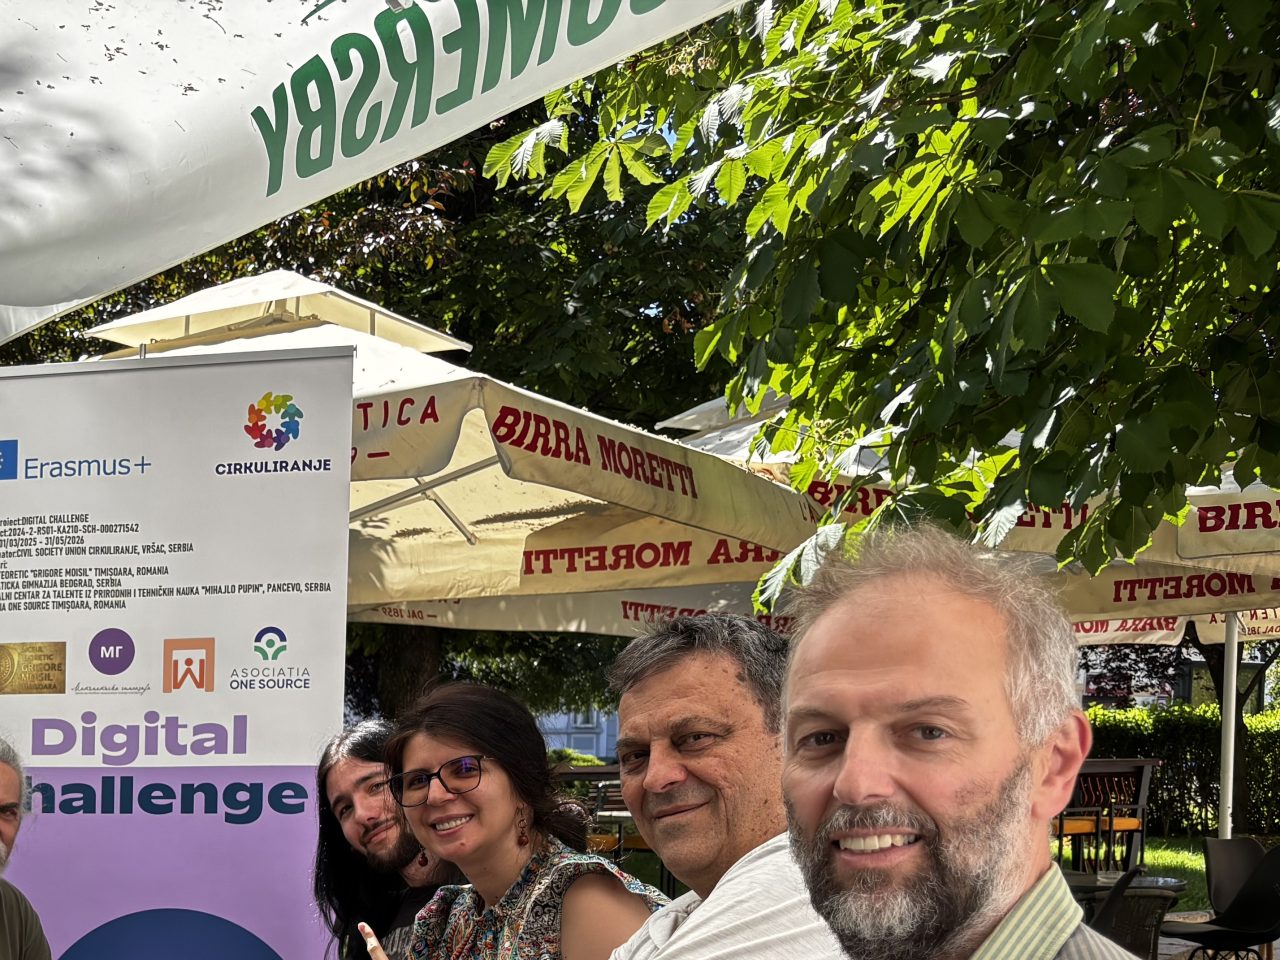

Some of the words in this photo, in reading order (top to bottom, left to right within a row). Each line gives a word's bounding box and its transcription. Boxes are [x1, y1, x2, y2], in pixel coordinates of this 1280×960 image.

[356, 395, 439, 431] TICA
[492, 405, 591, 466] BIRRA
[596, 434, 699, 499] MORETTI
[24, 455, 151, 480] Erasmus+
[215, 459, 331, 475] CIRKULIRANJE
[49, 514, 89, 524] CHALLENGE
[1197, 500, 1280, 533] BIR
[44, 536, 84, 546] 31/05/2026
[35, 547, 63, 557] SOCIETY
[65, 546, 86, 555] UNION
[88, 545, 140, 556] CIRKULIRANJE,
[168, 543, 194, 553] SERBIA
[30, 568, 63, 578] "GRIGORE
[65, 568, 92, 577] MOISIL"
[136, 566, 168, 576] ROMANIA
[14, 591, 40, 600] CENTAR
[42, 590, 51, 599] ZA
[52, 589, 83, 599] TALENTE
[85, 589, 91, 598] IZ
[93, 588, 131, 598] PRIRODNIH
[176, 587, 199, 596] NAUKA
[201, 584, 236, 595] "MIHAJLO
[305, 582, 332, 592] SERBIA
[22, 579, 58, 590] GIMNAZIJA
[59, 579, 94, 589] BEOGRAD,
[96, 578, 122, 588] SERBIA
[8, 602, 22, 611] ONE
[24, 600, 50, 610] SOURCE
[94, 599, 126, 609] ROMANIA
[231, 666, 310, 678] ASOCIATIA
[229, 679, 255, 690] ONE
[258, 677, 311, 689] SOURCE
[31, 711, 248, 766] Digital
[25, 775, 309, 825] hallenge
